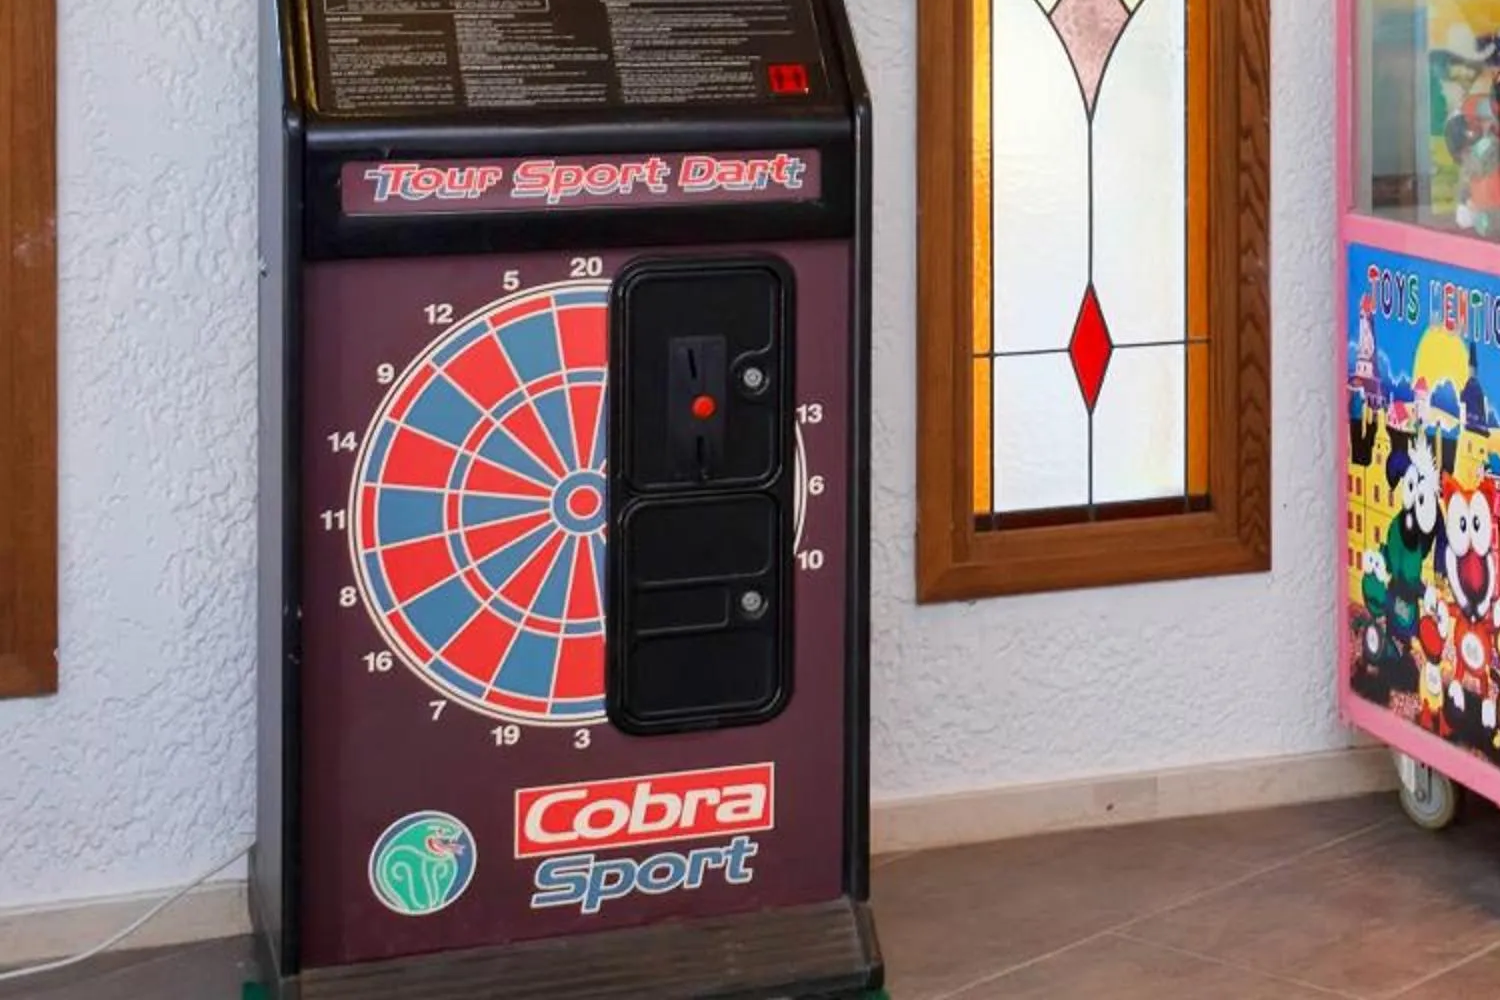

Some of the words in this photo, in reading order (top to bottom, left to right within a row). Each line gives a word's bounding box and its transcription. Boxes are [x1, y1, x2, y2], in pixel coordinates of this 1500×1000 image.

[364, 161, 503, 201] Tour
[511, 157, 672, 204] Sport
[678, 153, 806, 191] Dart
[570, 257, 603, 278] 20
[502, 270, 521, 291] 5
[1367, 263, 1420, 326] TOYS
[424, 304, 455, 325] 12
[376, 363, 396, 384] 9
[796, 403, 824, 424] 13
[327, 431, 358, 453] 14
[806, 475, 826, 495] 6
[321, 509, 346, 531] 11
[796, 550, 825, 571] 10
[339, 586, 358, 607] 8
[362, 650, 394, 672] 16
[429, 699, 448, 720] 7
[491, 724, 521, 746] 19
[573, 728, 592, 749] 3
[524, 782, 768, 844] Cobra
[530, 835, 759, 915] Sport
